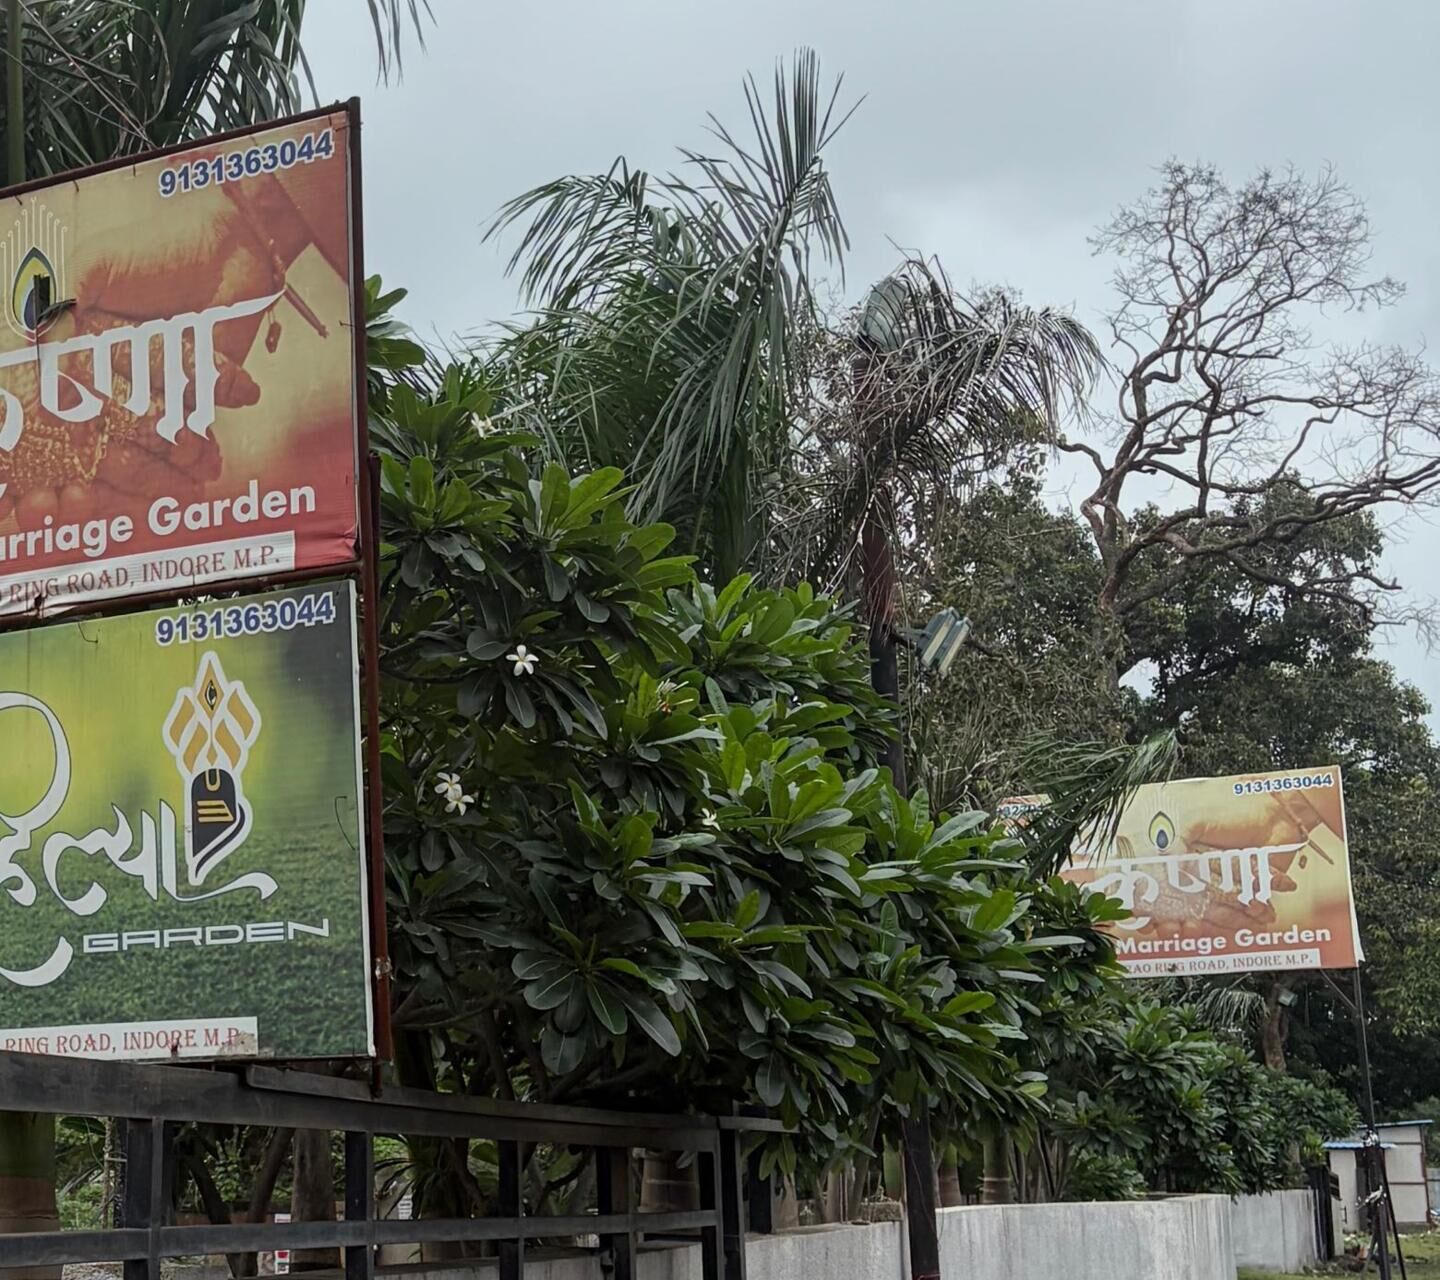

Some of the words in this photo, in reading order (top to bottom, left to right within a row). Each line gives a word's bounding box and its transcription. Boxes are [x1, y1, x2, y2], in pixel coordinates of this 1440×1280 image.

[160, 127, 335, 197] 9131363044
[148, 479, 316, 536] Garden
[10, 577, 60, 602] RING
[67, 567, 135, 594] ROAD,
[142, 552, 225, 582] INDORE
[233, 545, 280, 567] M.P.
[156, 591, 336, 646] 9131363044
[1233, 773, 1334, 797] 9131363044
[83, 918, 329, 954] GARDEN
[1116, 934, 1227, 955] Marriage
[1234, 924, 1331, 948] Garden
[1232, 956, 1281, 968] INDORE
[6, 1037, 49, 1056] RING
[56, 1033, 117, 1054] ROAD,
[123, 1028, 197, 1051] INDORE
